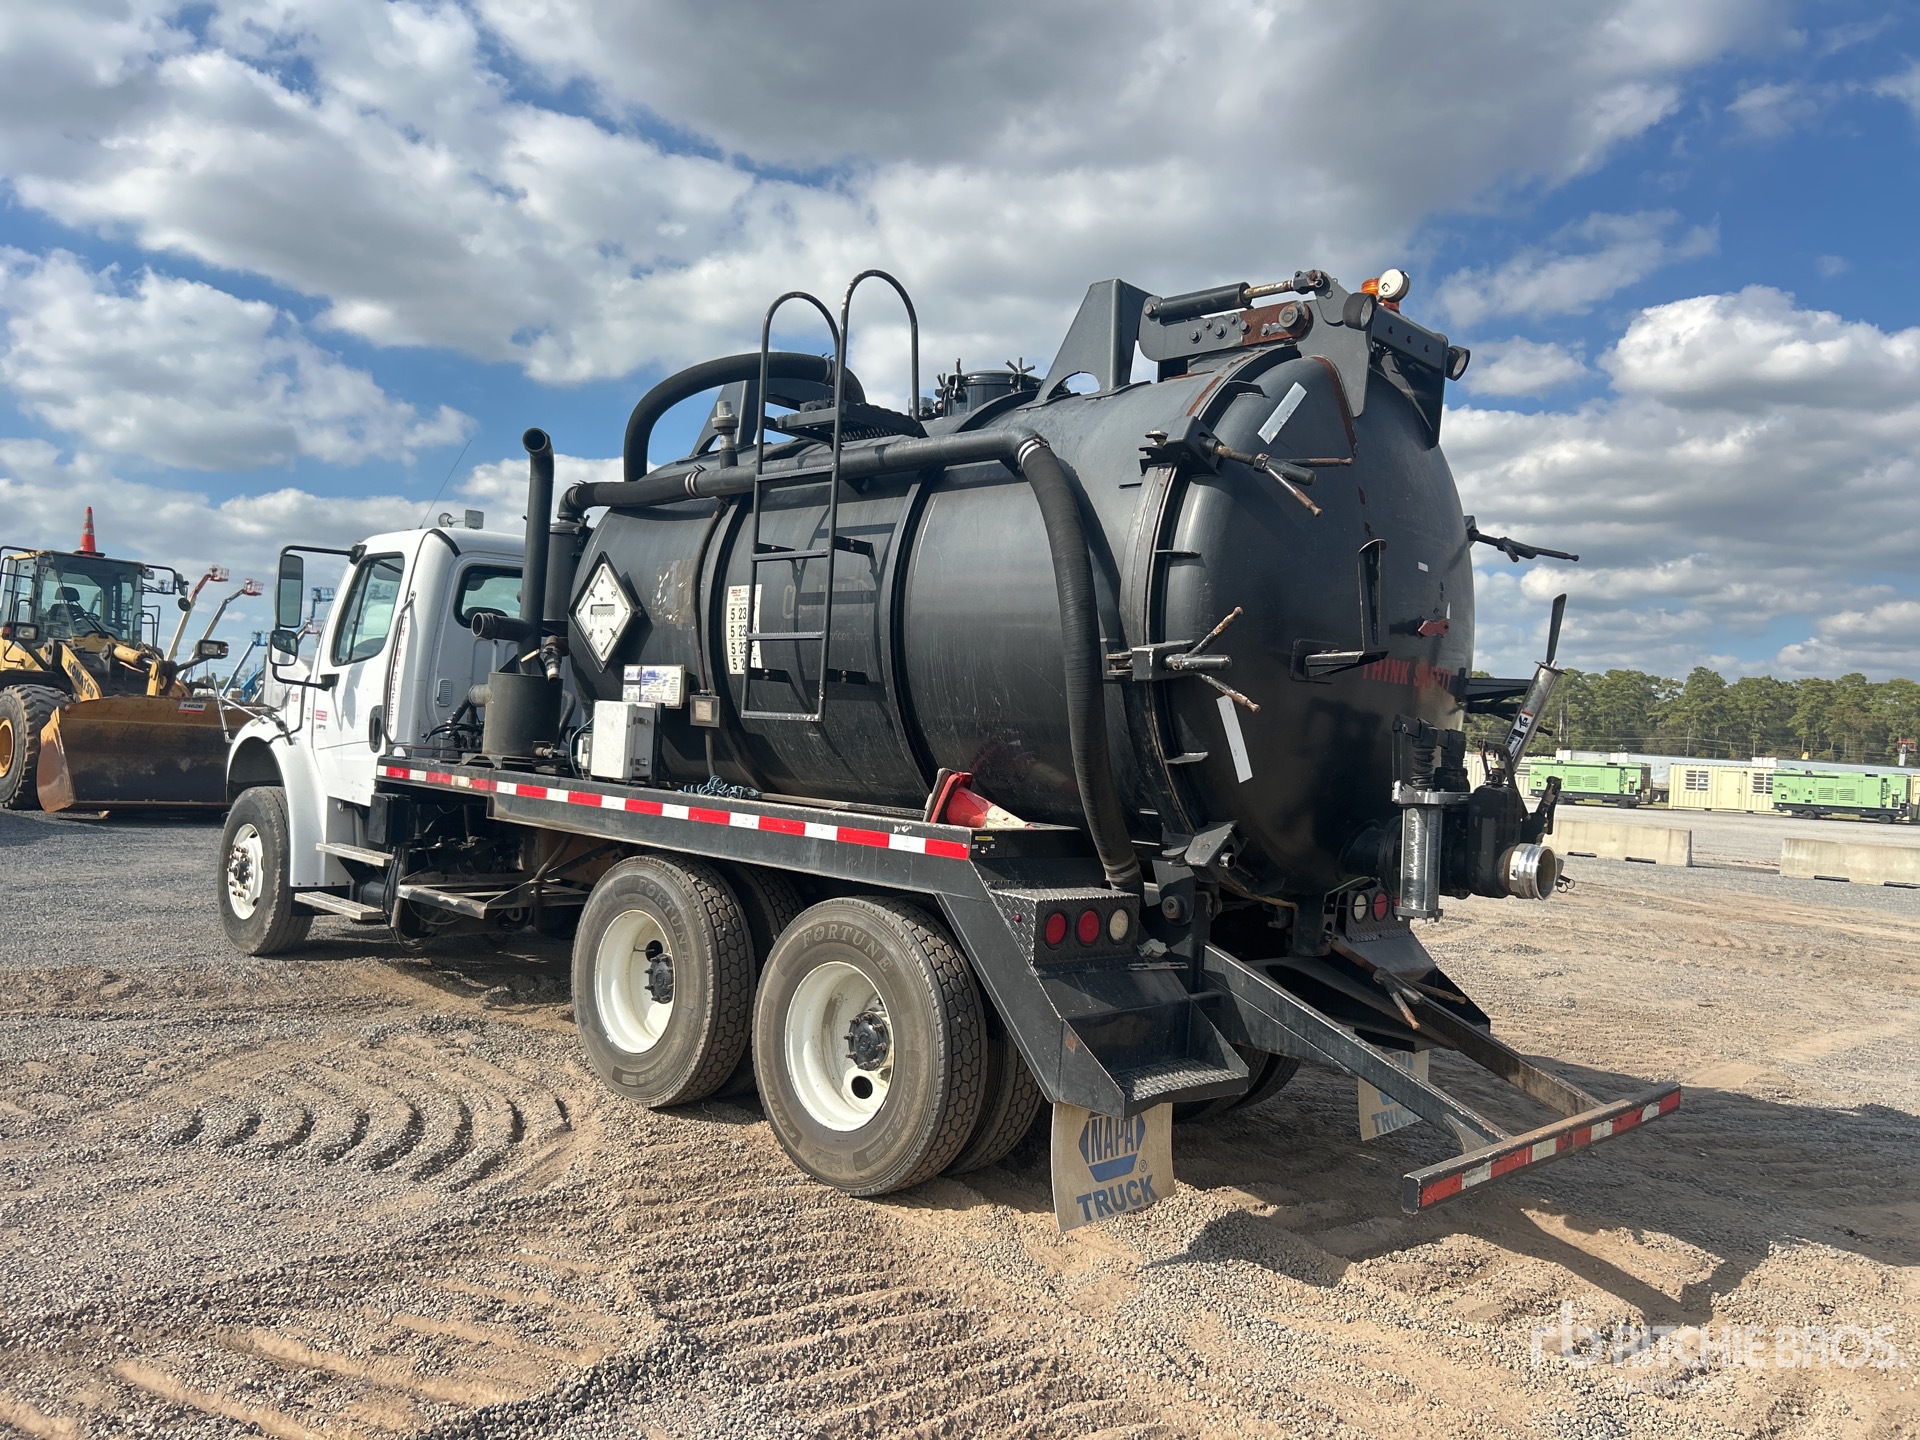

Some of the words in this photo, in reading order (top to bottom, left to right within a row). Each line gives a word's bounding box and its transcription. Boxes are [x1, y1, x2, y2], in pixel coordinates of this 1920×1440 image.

[730, 607, 736, 621] 5
[738, 606, 748, 620] 23
[730, 625, 736, 638] 5
[738, 624, 748, 637] 23
[731, 642, 737, 655] 5
[732, 657, 738, 670] 5
[1362, 659, 1410, 685] THINK
[67, 659, 95, 699] KOMATSU
[802, 924, 893, 972] FORTUNE
[1091, 1116, 1134, 1163] NAPA
[1076, 1174, 1158, 1221] TRUCK
